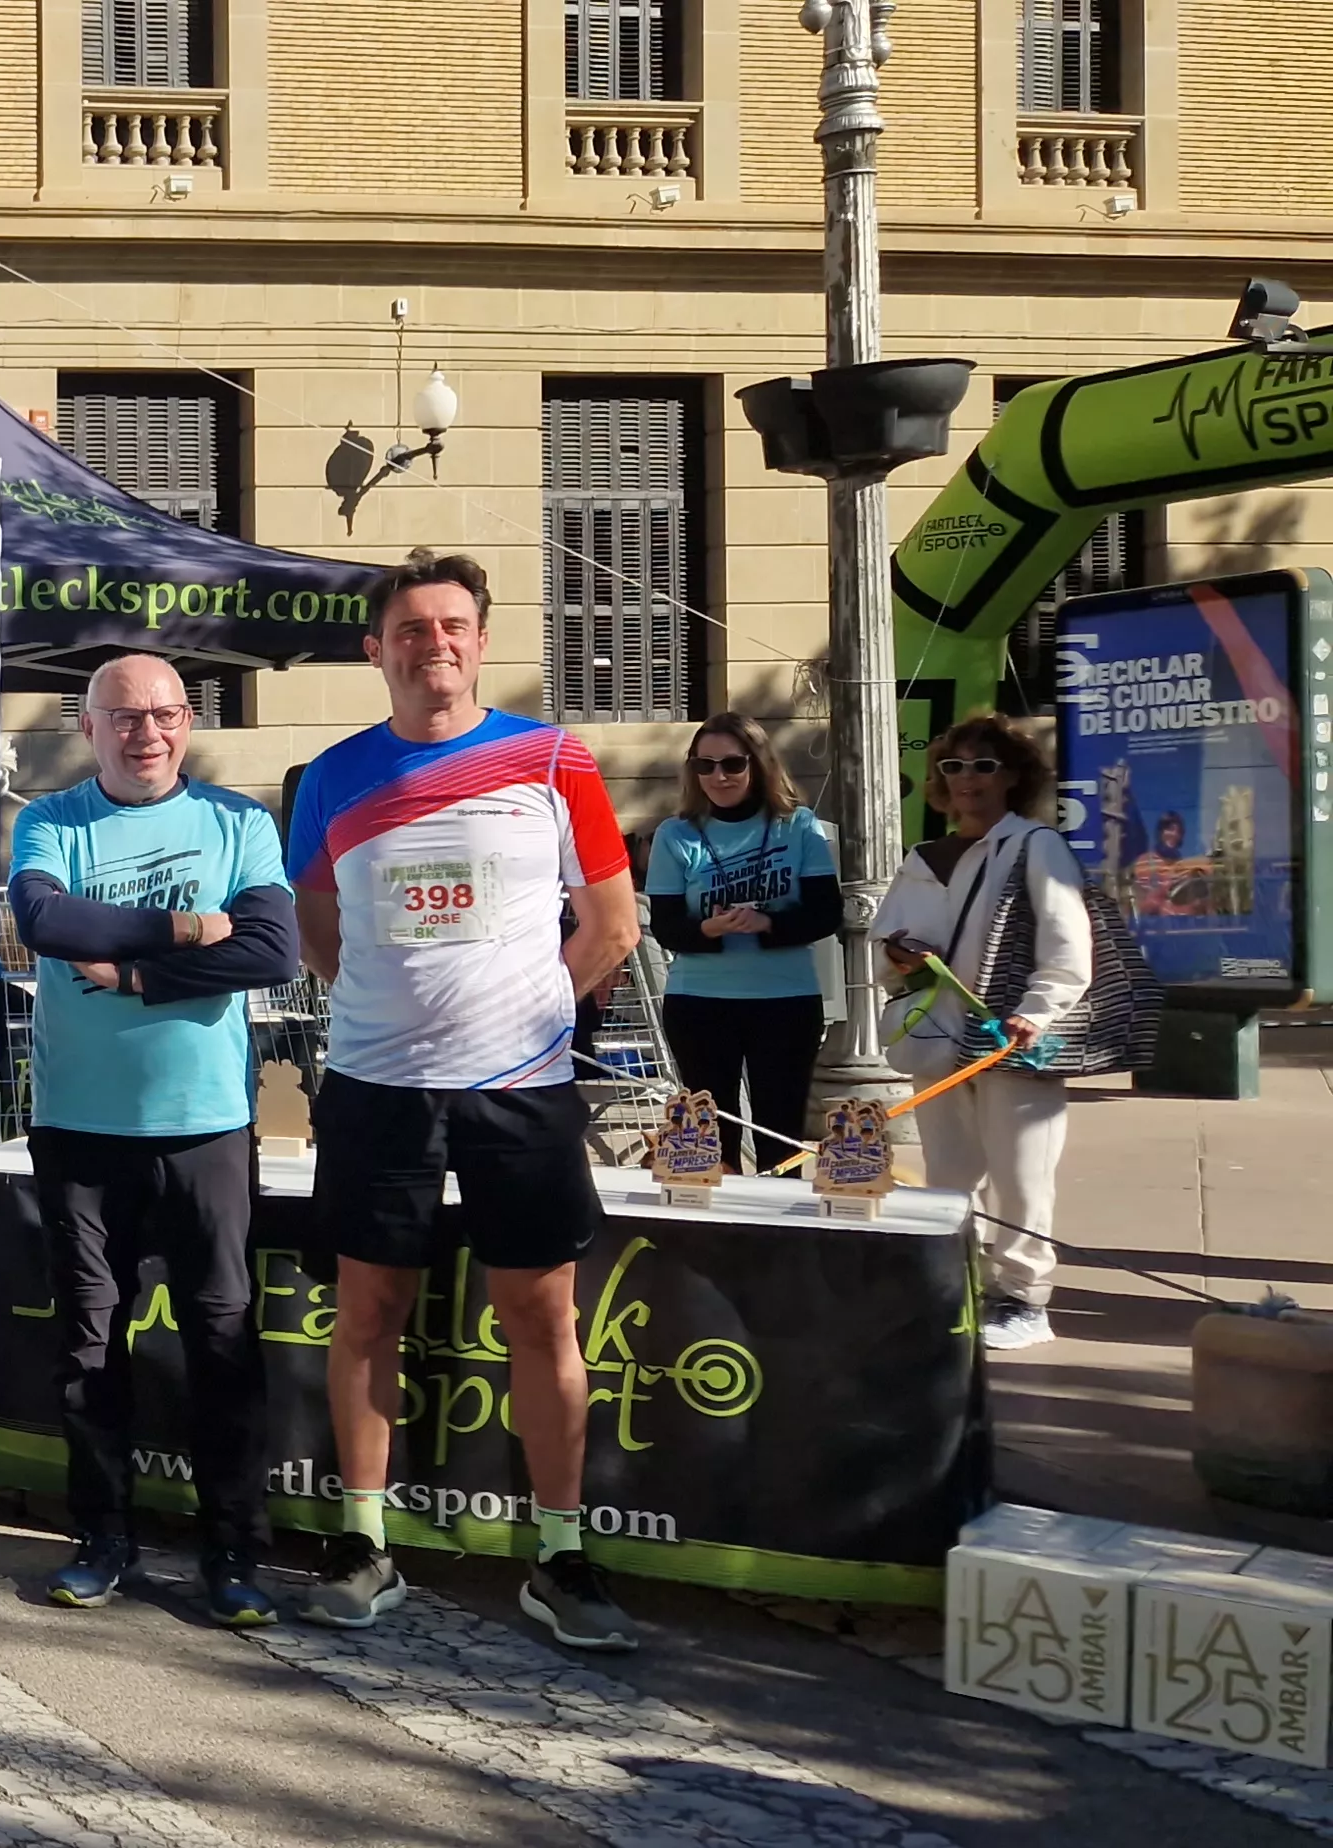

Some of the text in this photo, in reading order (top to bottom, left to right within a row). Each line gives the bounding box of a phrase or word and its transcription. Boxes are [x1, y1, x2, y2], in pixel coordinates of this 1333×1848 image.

[1254, 354, 1333, 391] FAR
[1263, 401, 1333, 446] SP
[926, 514, 985, 531] FARTLECK
[924, 533, 988, 552] SPORT
[1079, 653, 1203, 687] RECICLAR
[1079, 678, 1212, 711] ES CUIDAR
[1079, 697, 1280, 736] DE LO NUESTRO
[108, 867, 173, 900] CARRERA
[419, 861, 472, 873] CARRERA
[404, 883, 475, 911] 398
[413, 926, 437, 939] 8K
[418, 913, 461, 925] JOSE
[668, 1153, 720, 1169] EMPRESAS
[829, 1164, 883, 1179] EMPRESAS
[665, 1189, 672, 1205] 1
[824, 1200, 831, 1216] 1
[978, 1567, 1070, 1652] LA
[959, 1616, 1073, 1703] 125
[1080, 1611, 1108, 1713] AMBAR
[1166, 1602, 1268, 1691] LA
[1146, 1652, 1273, 1745] 125
[1278, 1649, 1309, 1753] AMBAR
